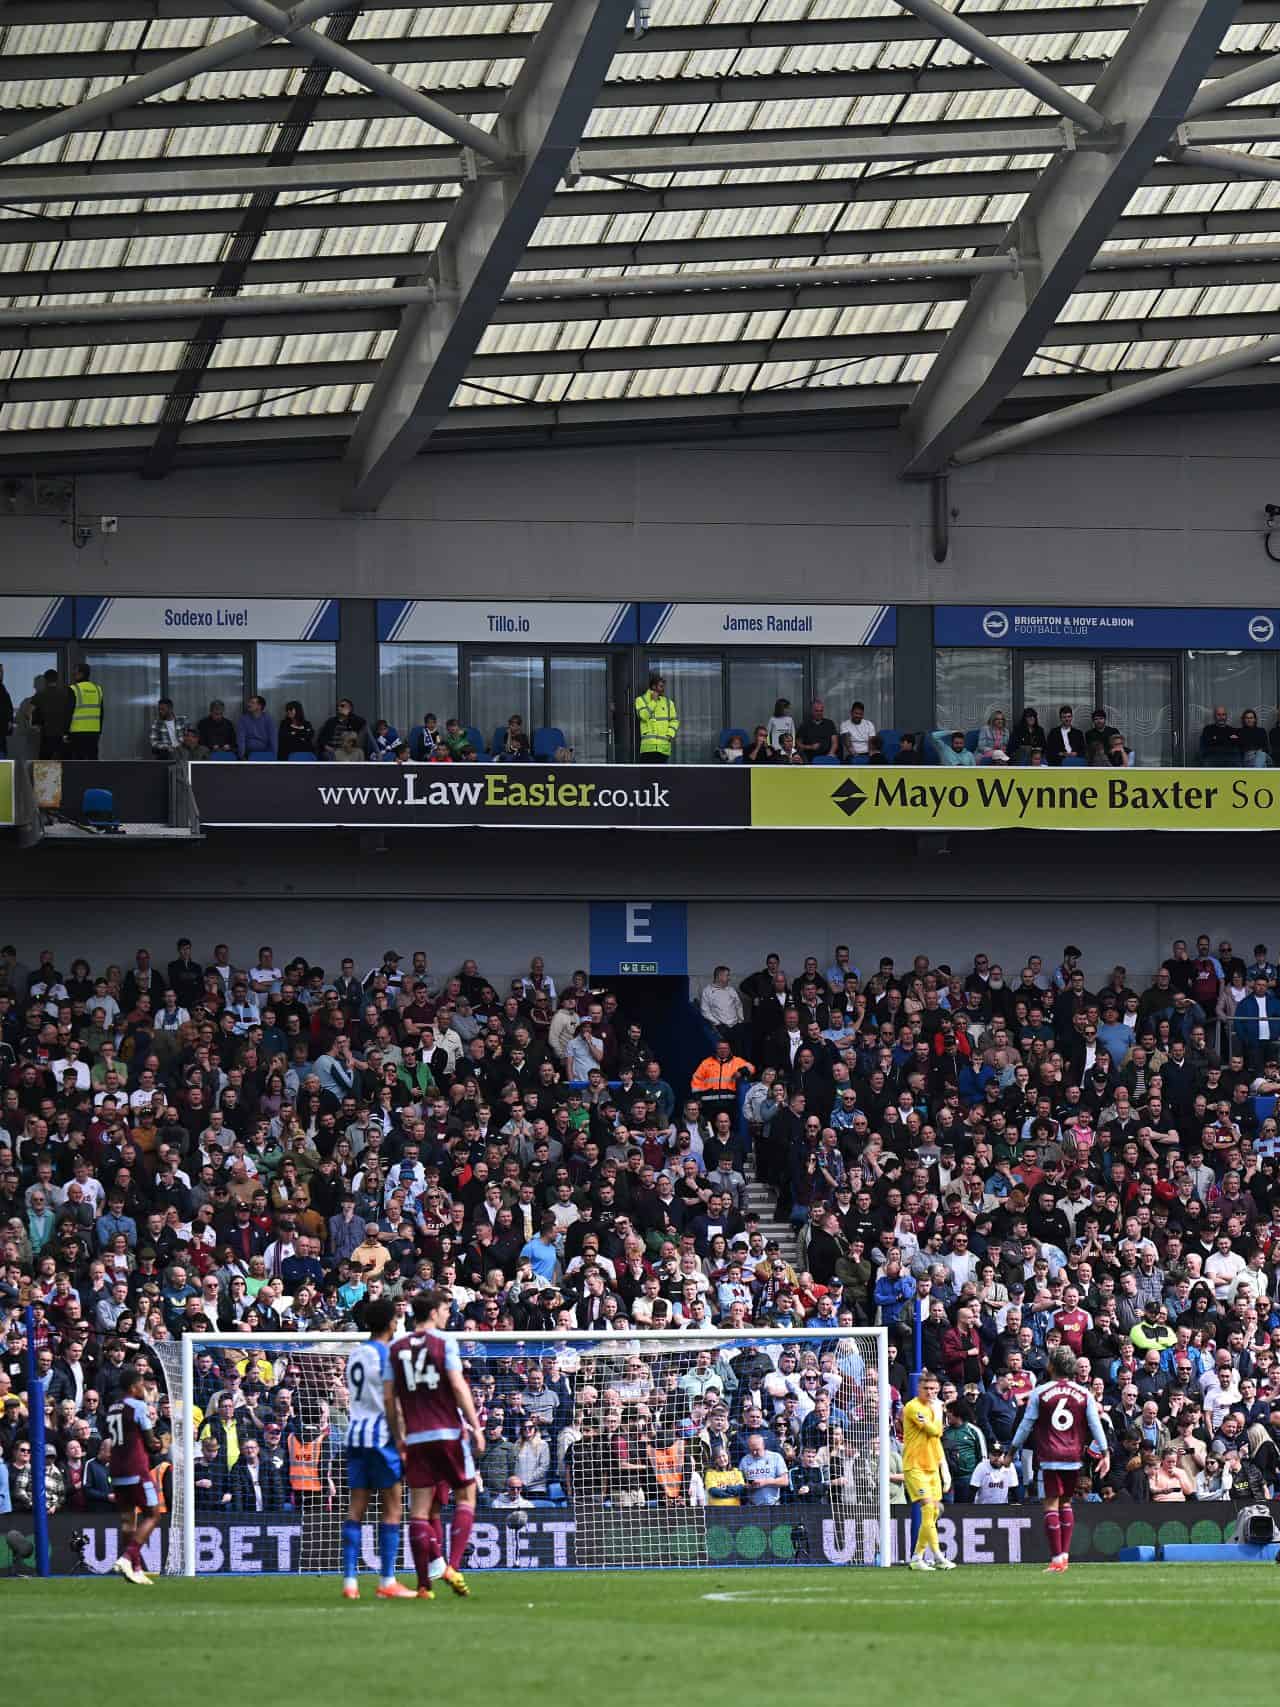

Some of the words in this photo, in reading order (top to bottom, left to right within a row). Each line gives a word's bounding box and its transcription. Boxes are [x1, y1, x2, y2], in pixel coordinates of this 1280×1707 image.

[165, 609, 213, 626] Sodexo
[216, 609, 248, 626] Live!
[487, 615, 530, 632] Tillo.io
[722, 615, 763, 631] James
[767, 615, 813, 632] Randall
[1014, 616, 1062, 625] BRIGHTON
[1064, 617, 1071, 626] &
[1073, 617, 1098, 626] HOVE
[1099, 618, 1134, 627] ALBION
[1014, 625, 1062, 635] FOOTBALL
[1064, 626, 1088, 635] CLUB
[318, 773, 670, 807] www.LawEasier.co.uk
[874, 778, 970, 818] Mayo
[976, 778, 1098, 818] Wynne
[1107, 779, 1218, 810] Baxter
[626, 903, 652, 943] E
[640, 964, 655, 972] Exit
[350, 1361, 365, 1401] 9
[398, 1347, 440, 1391] 14
[1051, 1398, 1074, 1431] 6
